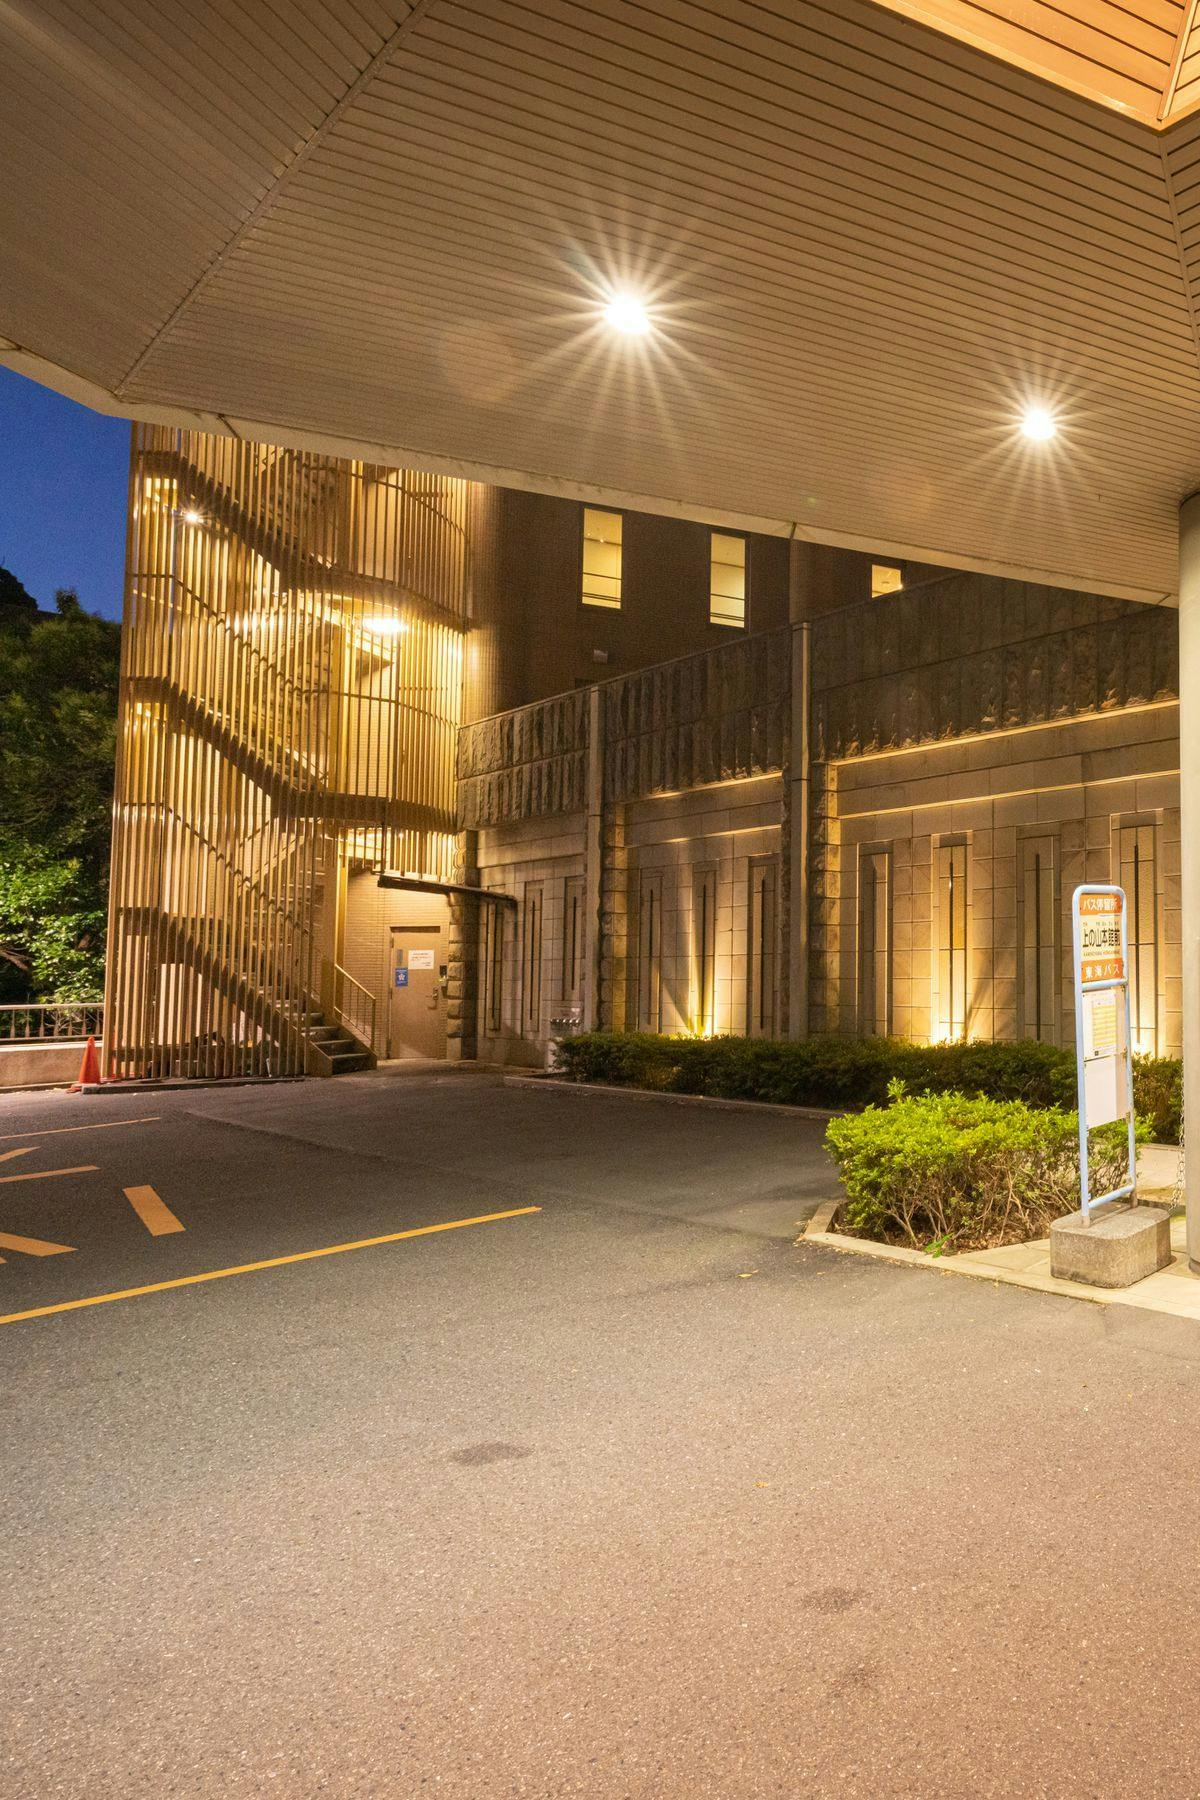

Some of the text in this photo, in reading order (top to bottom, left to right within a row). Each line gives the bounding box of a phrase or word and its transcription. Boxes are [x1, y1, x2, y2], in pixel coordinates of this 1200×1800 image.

[1083, 898, 1117, 911] バス停留所
[1085, 964, 1120, 979] 東海バス
